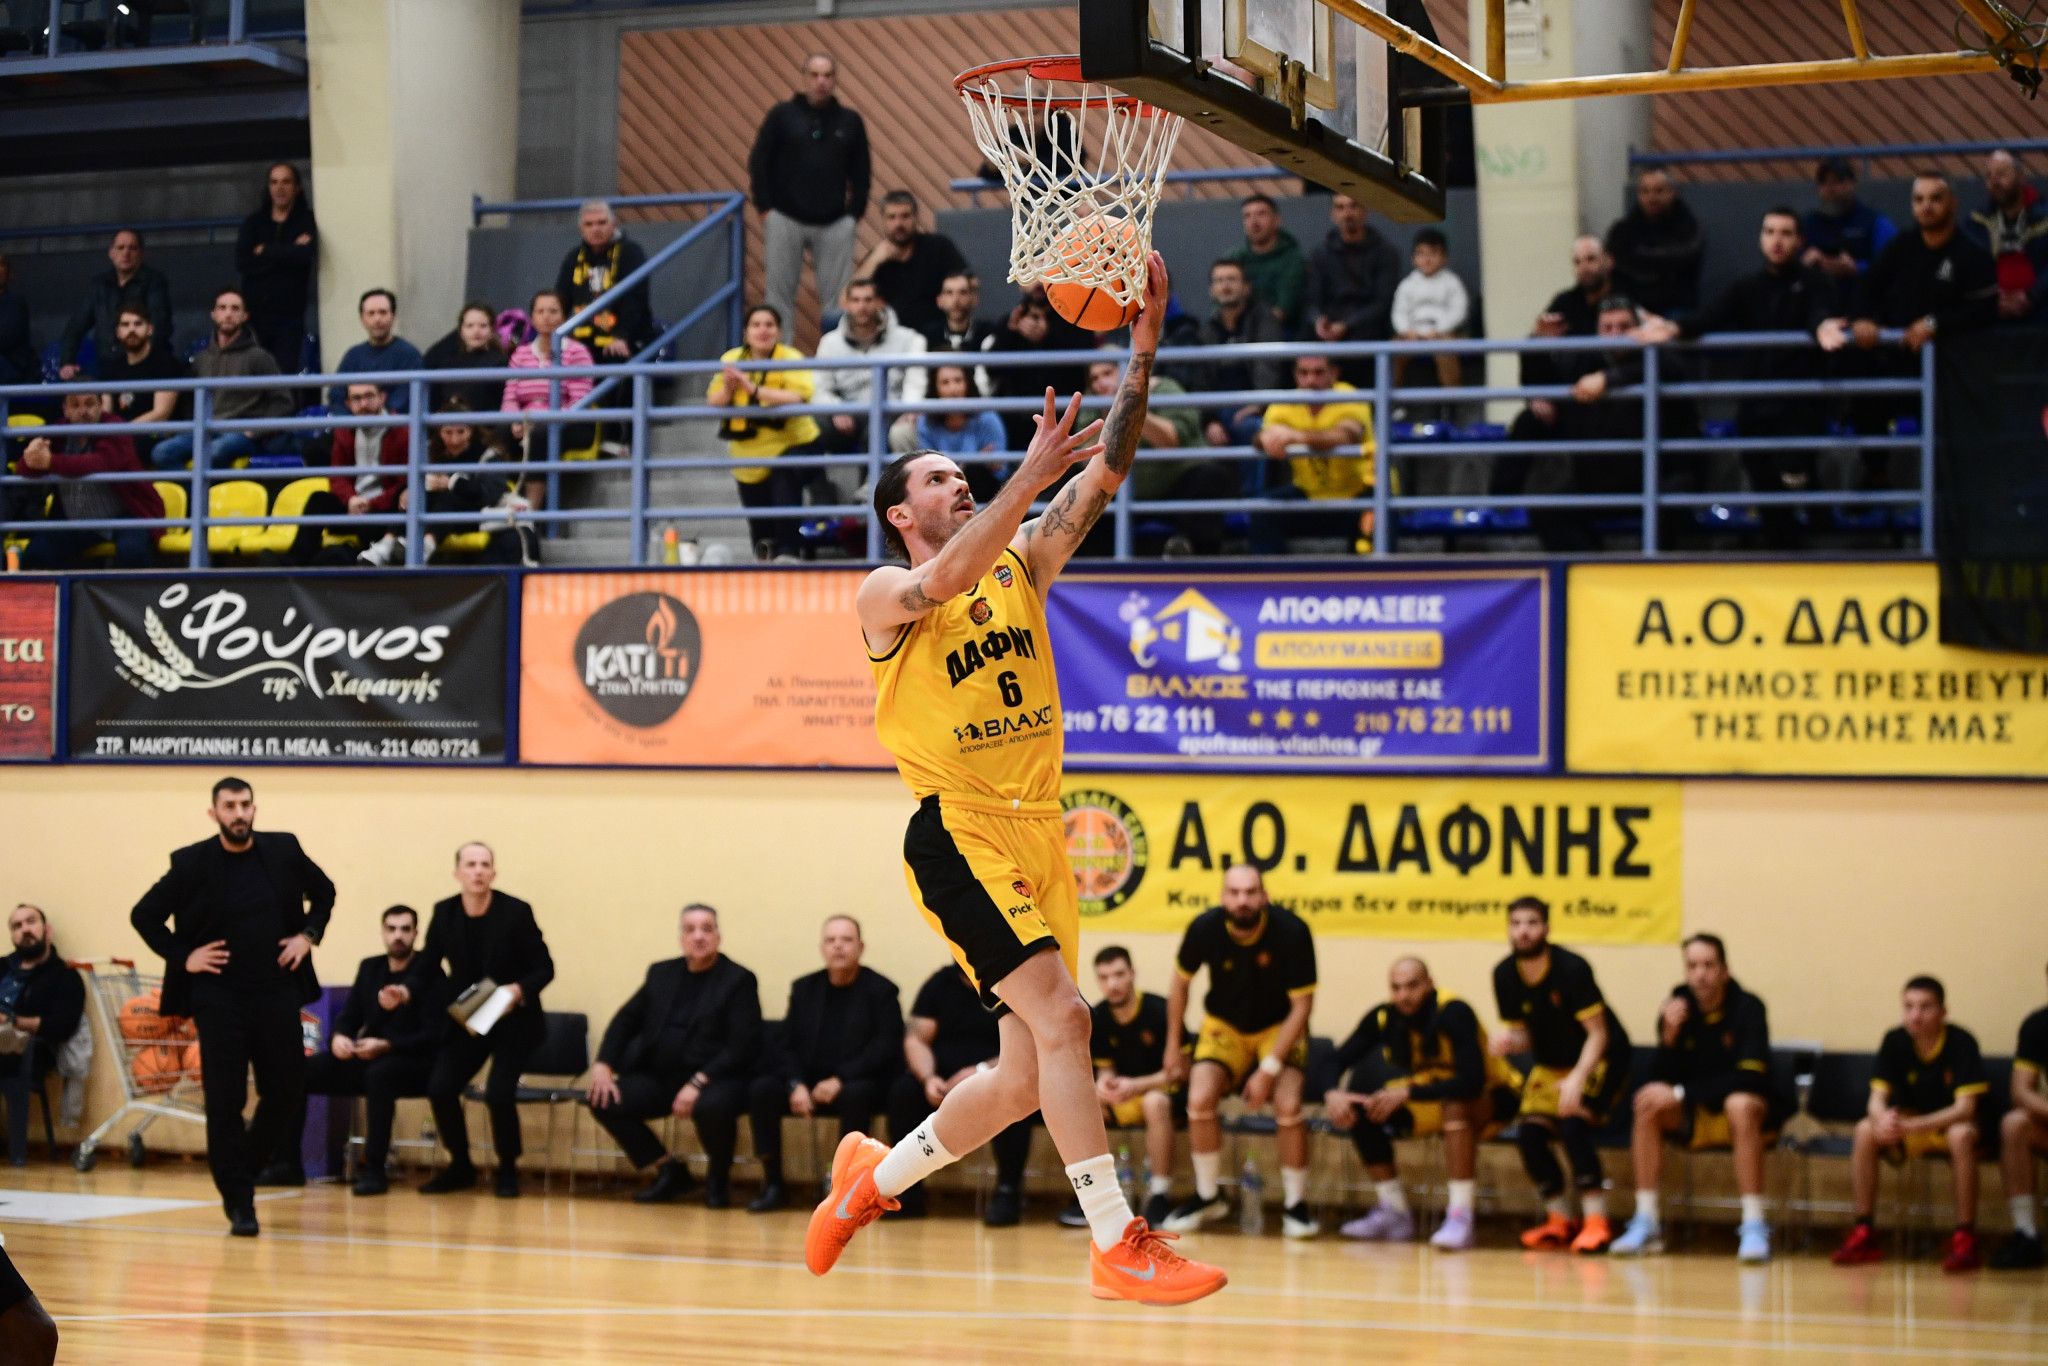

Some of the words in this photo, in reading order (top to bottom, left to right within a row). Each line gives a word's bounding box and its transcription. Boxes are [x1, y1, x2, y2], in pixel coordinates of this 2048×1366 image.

[1258, 594, 1445, 624] ΑΠΟΦΡΑΞΕΙΣ
[1636, 597, 1764, 646] Α.Ο.
[181, 589, 449, 698] Φούρνος
[1268, 640, 1433, 659] ΑΠΟΛΥΜΑΝΣΕΙΣ
[261, 677, 299, 702] της
[325, 670, 442, 704] Χαραυγής
[997, 671, 1023, 707] 6
[1254, 678, 1292, 700] ΤΗΣ
[1296, 678, 1398, 700] ΠΕΡΙΟΧΗΣ
[1402, 678, 1443, 700] ΣΑΣ
[1617, 671, 1820, 700] ΕΠΙΣΗΜΟΣ
[1063, 710, 1097, 732] 210
[1098, 704, 1130, 733] 76
[1134, 704, 1168, 733] 22
[1174, 705, 1215, 733] 111
[1354, 712, 1391, 734] 210
[1394, 706, 1427, 734] 76
[1431, 706, 1464, 734] 22
[1470, 706, 1512, 734] 111
[1692, 712, 1764, 744] ΤΗΣ
[1776, 712, 1913, 744] ΠΟΛΗΣ
[1928, 712, 2012, 744] ΜΑΣ
[130, 737, 239, 756] ΜΑΚΡΥΓΙΑΝΝΗ
[252, 737, 264, 756] &
[284, 737, 330, 757] ΜΕΛΑ
[380, 738, 409, 757] 211
[410, 738, 439, 758] 400
[441, 738, 480, 758] 9724
[960, 739, 1003, 754] ΑΠΟΦΡΑΞΕΙΣ
[1169, 800, 1306, 872] Α.Ο.
[1335, 804, 1653, 878] ΔΑΦΝΗΣ
[1008, 902, 1032, 918] Pick
[917, 1130, 934, 1156] 23
[1073, 1174, 1093, 1189] 23
